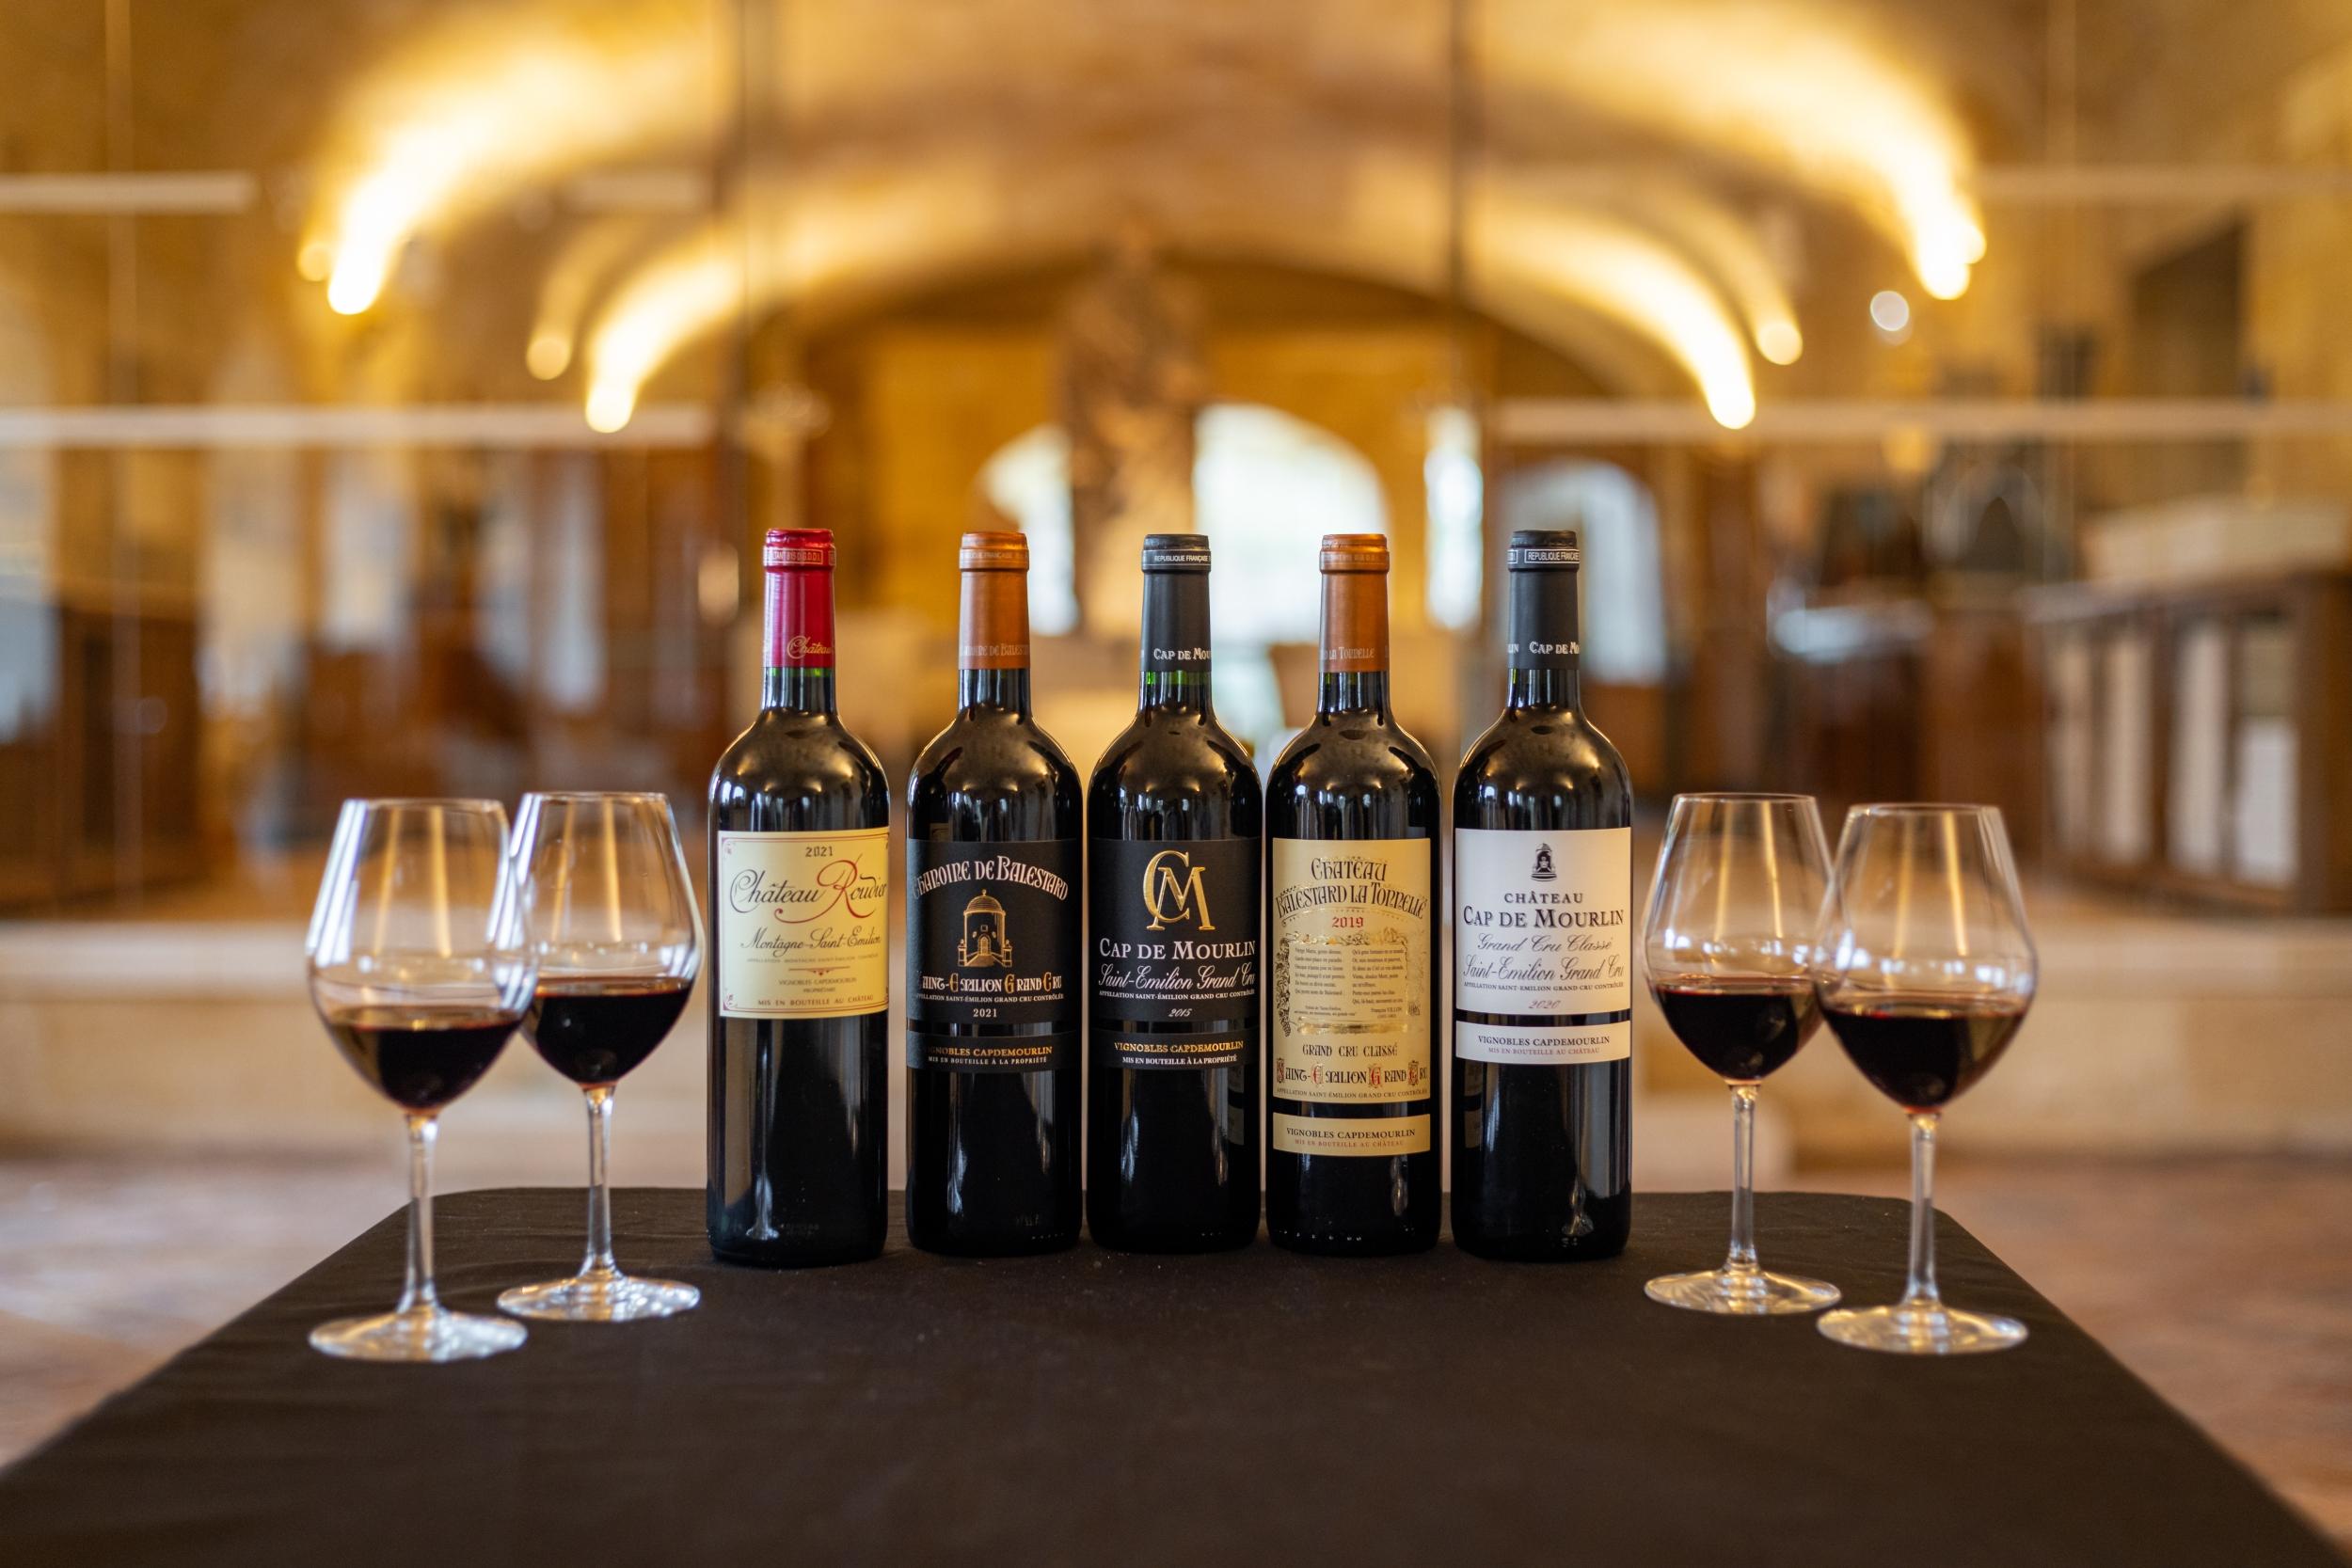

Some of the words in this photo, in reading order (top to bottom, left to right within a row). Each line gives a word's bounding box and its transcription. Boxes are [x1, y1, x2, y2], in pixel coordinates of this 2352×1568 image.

[1153, 648, 1175, 660] CAP
[1177, 650, 1192, 660] DE
[1529, 641, 1553, 655] CAP
[1555, 643, 1568, 655] DE
[805, 846, 833, 858] 2021
[975, 860, 994, 880] DE
[995, 855, 1069, 900] BALESTARD
[730, 869, 826, 913] Château
[1504, 891, 1583, 904] CHÂTEAU
[1276, 885, 1347, 919] BALESTARD
[1350, 885, 1368, 904] LA
[1332, 916, 1364, 928] 2019
[1463, 906, 1493, 927] CAP
[1498, 912, 1527, 928] DE
[1534, 909, 1624, 928] MOURLIN
[1099, 938, 1132, 958] CAP
[1137, 944, 1167, 959] DE
[1172, 941, 1256, 959] MOURLIN
[1477, 933, 1528, 951] Grand
[1532, 935, 1562, 952] Cru
[1463, 954, 1554, 980] Saint-Emilion
[1560, 957, 1605, 980] Grand
[1608, 954, 1624, 977] Cru
[1098, 963, 1194, 990] Saint-Emilion
[1197, 965, 1241, 990] Grand
[1242, 961, 1256, 986] Cru
[1004, 974, 1042, 994] GRAND
[1042, 972, 1062, 992] CRU
[1099, 990, 1135, 999] APPELLATION
[790, 998, 830, 1006] BOUTEILLE
[973, 1008, 997, 1018] 2021
[1168, 1008, 1193, 1017] 2015
[1114, 1042, 1168, 1053] VIGNOBLES
[1170, 1040, 1244, 1053] CAPDEMOURLIN
[1478, 1035, 1530, 1046] VIGNOBLES
[1533, 1036, 1610, 1047] CAPDEMOURLIN
[973, 1046, 1053, 1057] CAPDEMOURLIN
[1302, 1044, 1332, 1057] GRAND
[1338, 1045, 1358, 1057] CRU
[1363, 1042, 1398, 1057] CLASSÉ
[950, 1057, 989, 1066] BOUTEILLE
[1203, 1053, 1237, 1065] PROPRIÉTÉ
[1369, 1065, 1406, 1087] GRAND
[1286, 1127, 1334, 1138] VIGNOBLES
[1337, 1128, 1416, 1139] CAPDEMOURLIN
